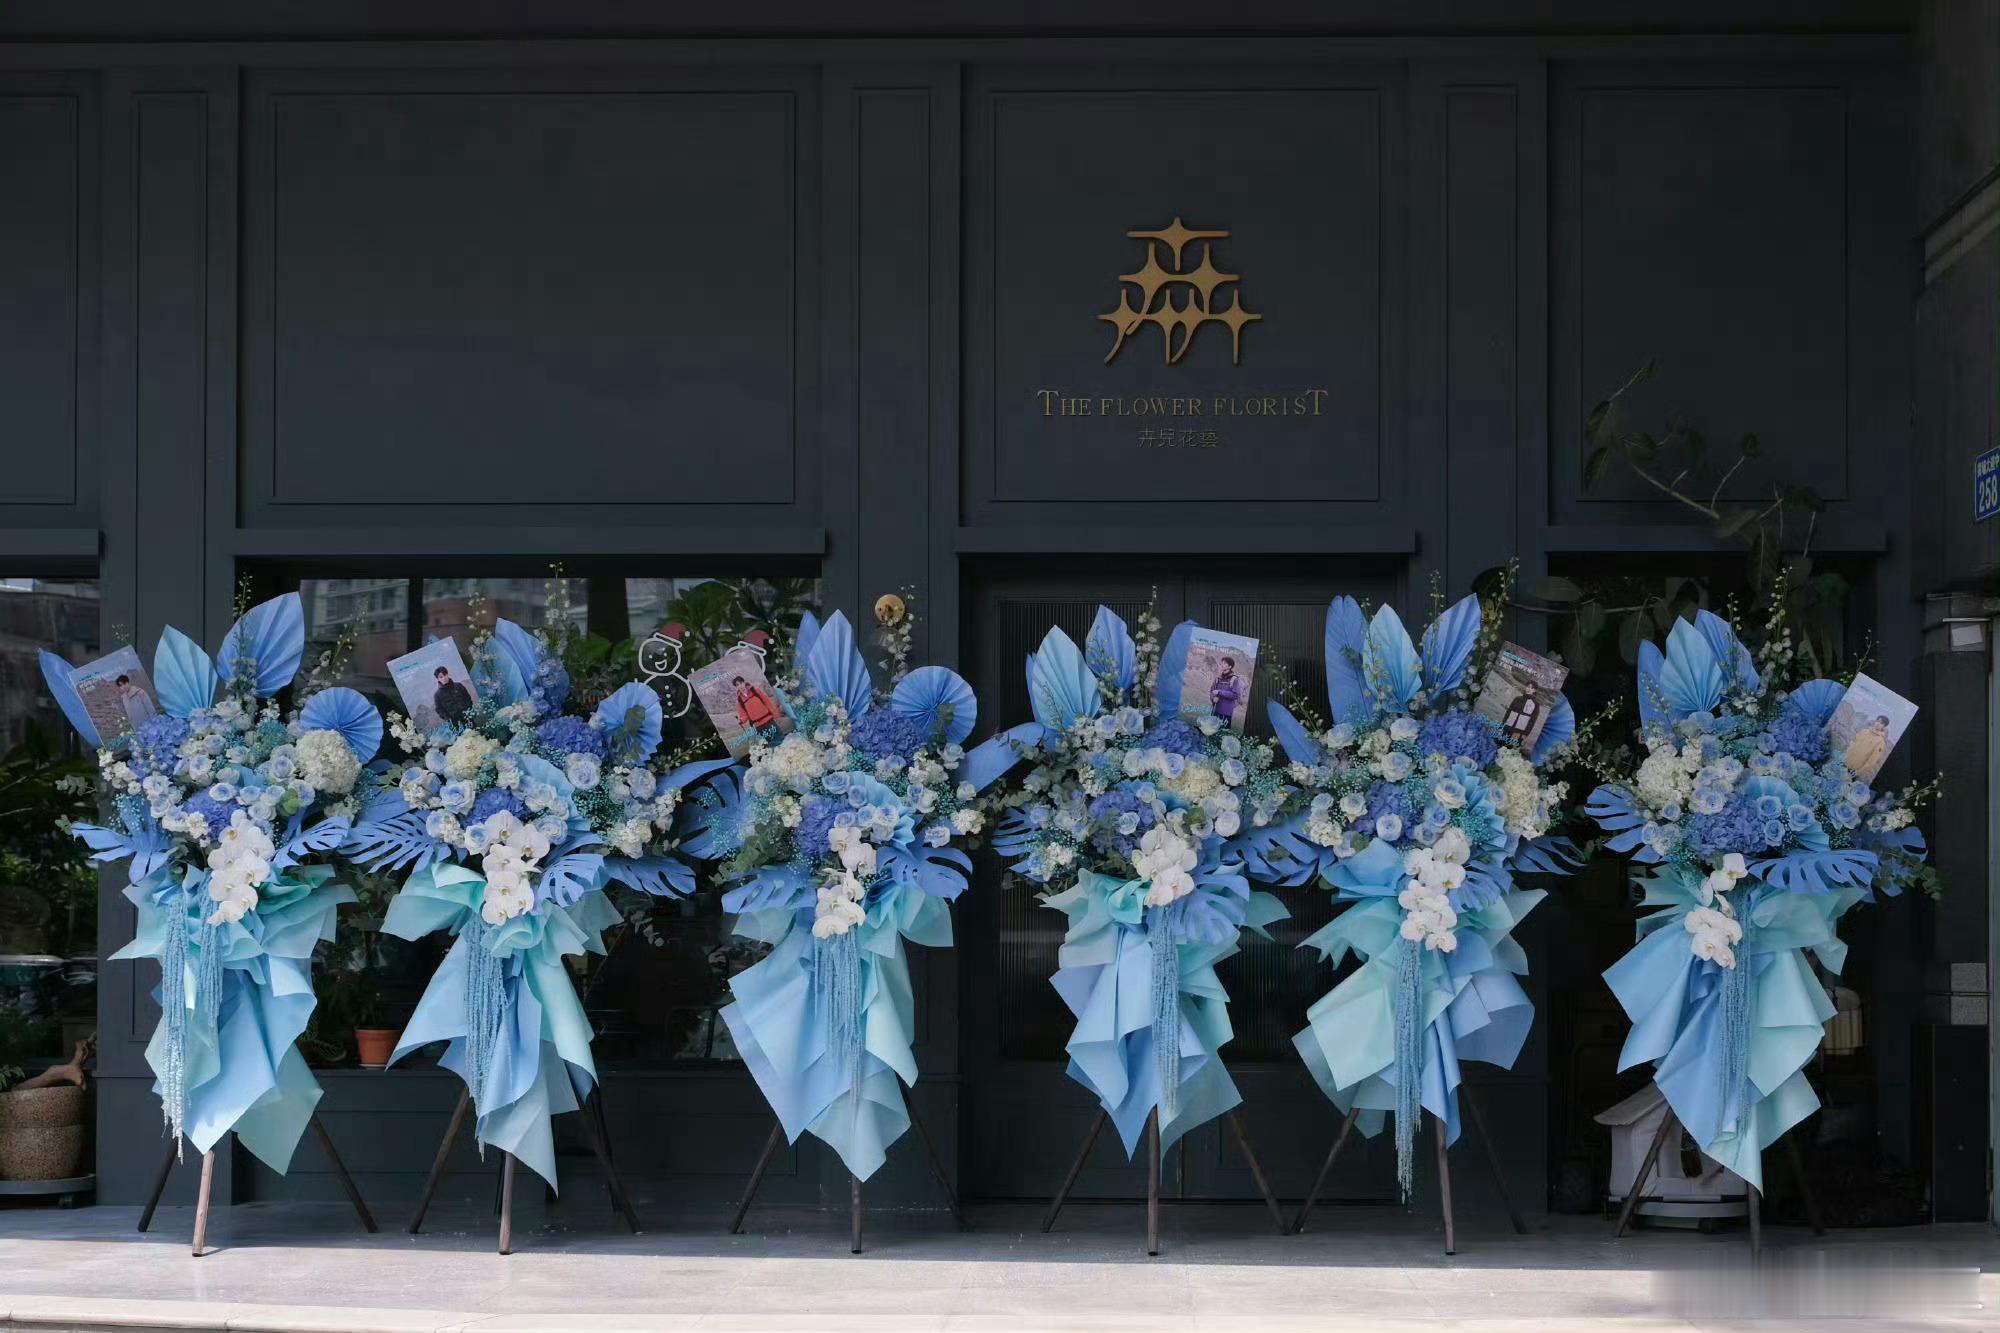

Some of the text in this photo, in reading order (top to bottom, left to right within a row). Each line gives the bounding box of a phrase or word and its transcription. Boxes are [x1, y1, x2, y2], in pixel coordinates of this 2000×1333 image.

[1100, 397, 1202, 416] FLOWER
[1214, 389, 1328, 416] FLORIST
[1979, 474, 1998, 513] 258
